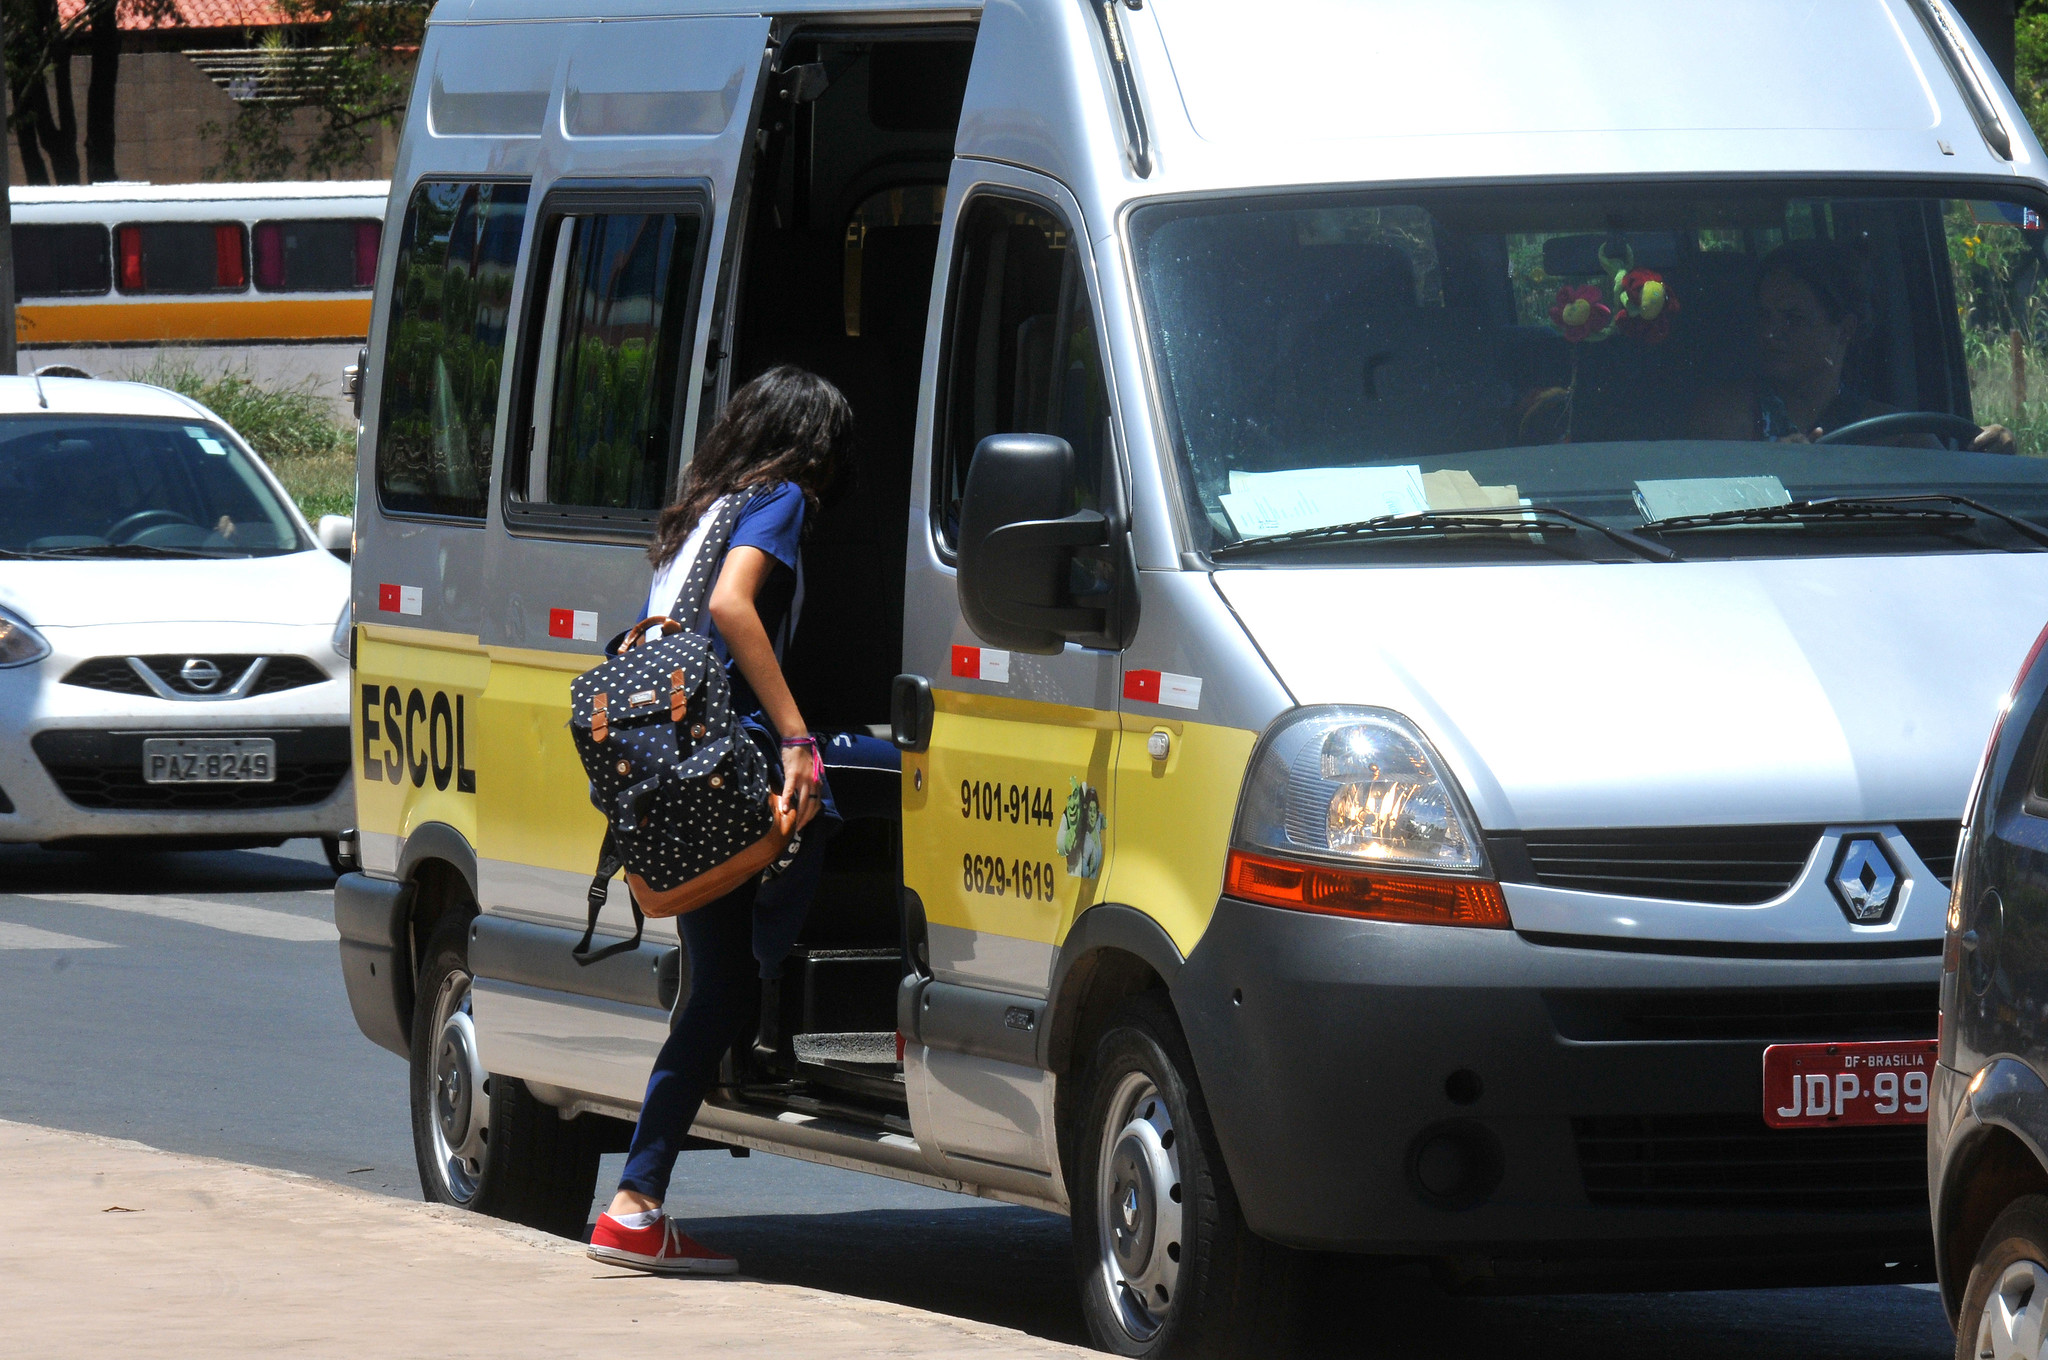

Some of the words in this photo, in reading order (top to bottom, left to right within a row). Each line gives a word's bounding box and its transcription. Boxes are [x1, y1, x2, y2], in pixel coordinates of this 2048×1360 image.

[362, 684, 476, 794] ESCOL
[961, 779, 1053, 828] 9101-9144
[963, 853, 1054, 902] 8629-1619
